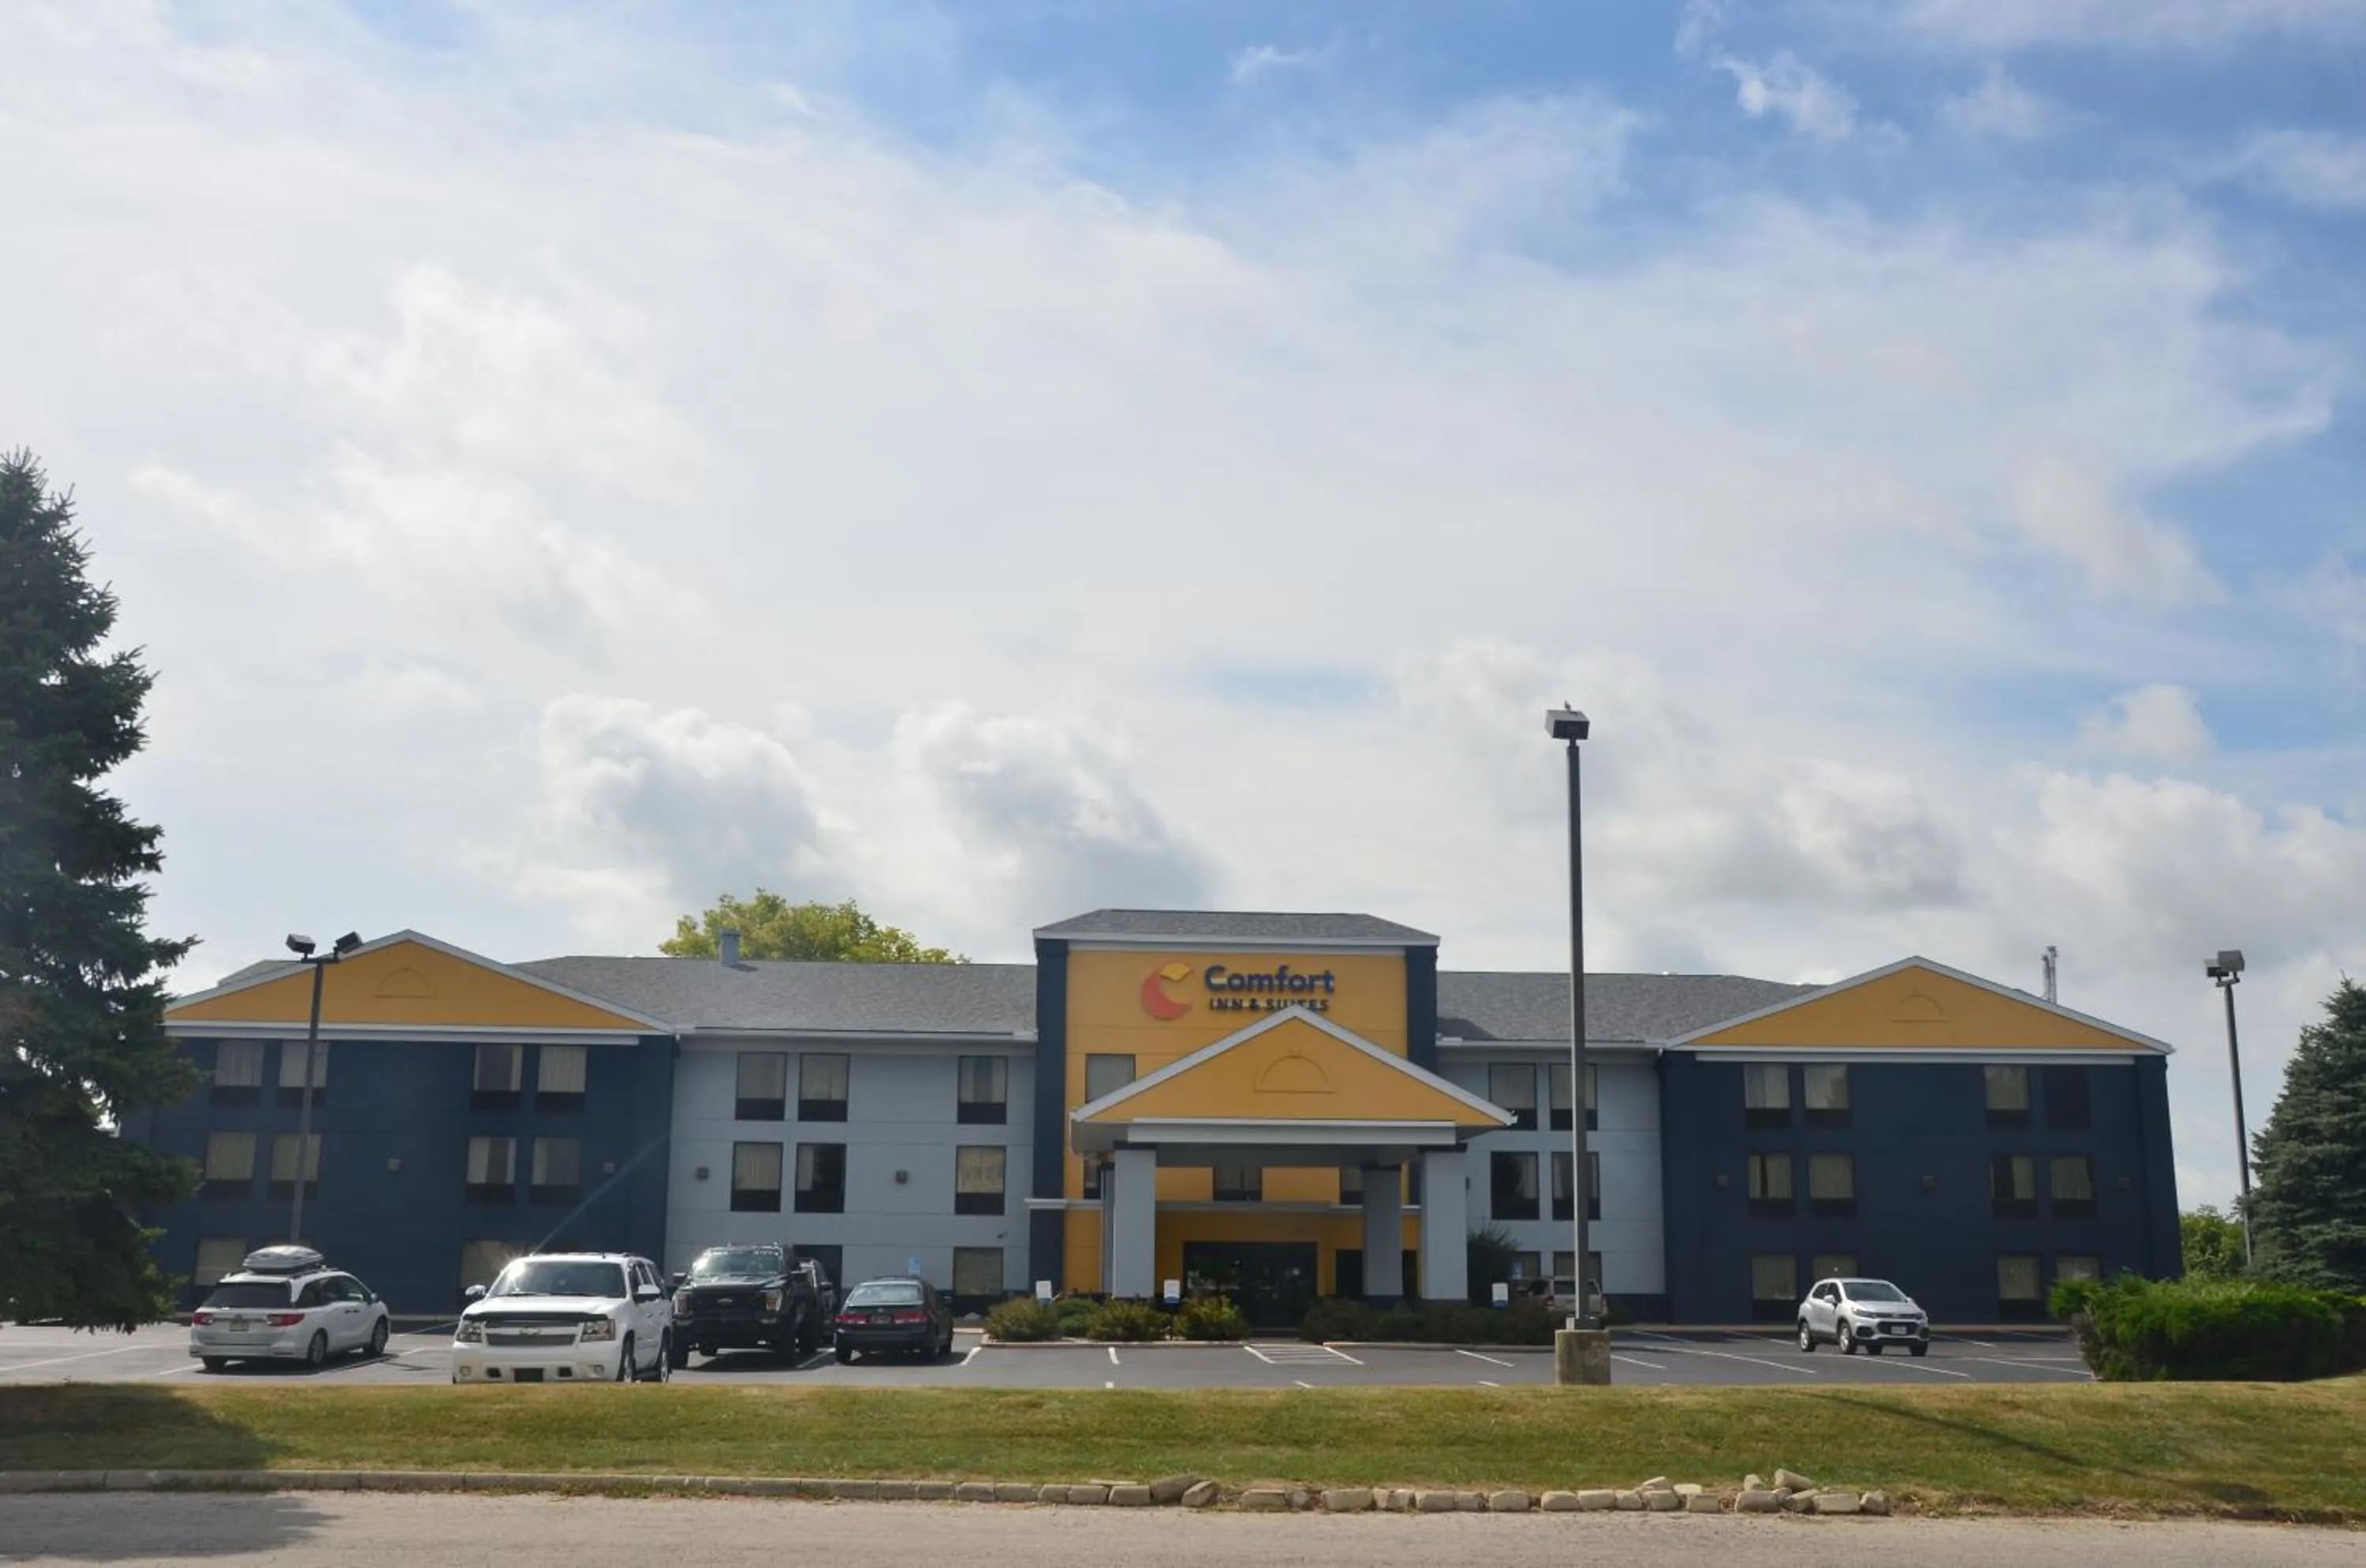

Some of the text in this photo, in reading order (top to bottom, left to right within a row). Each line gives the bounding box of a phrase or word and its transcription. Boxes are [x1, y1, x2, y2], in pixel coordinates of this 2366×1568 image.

[1205, 965, 1334, 994] Comfort
[1209, 998, 1243, 1010] INN
[1249, 998, 1260, 1011] &
